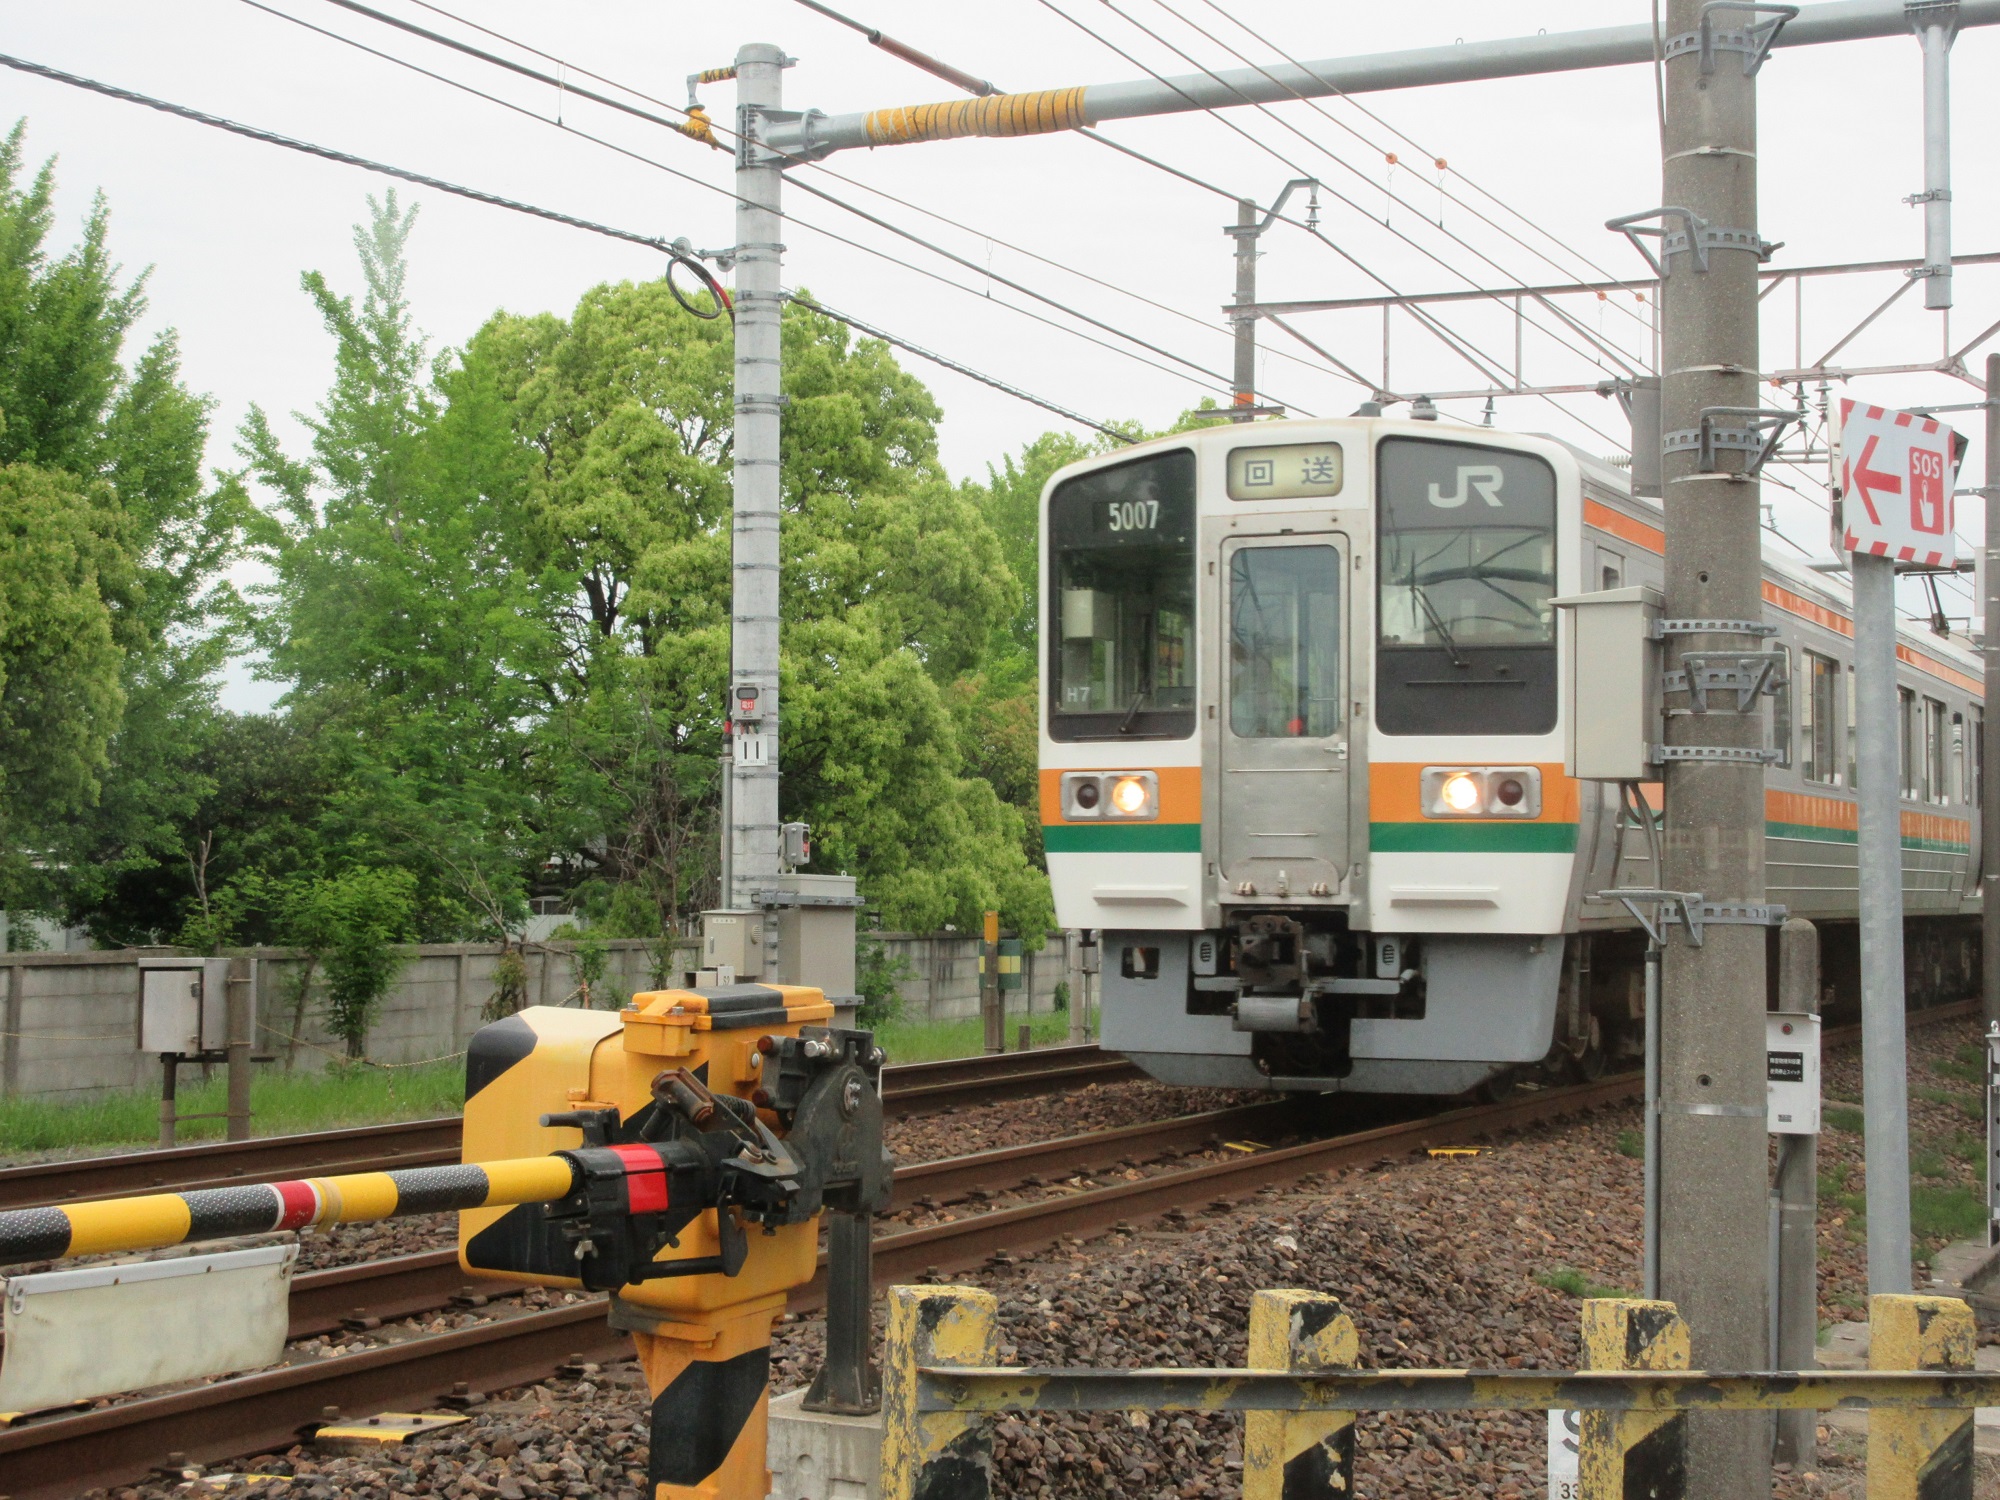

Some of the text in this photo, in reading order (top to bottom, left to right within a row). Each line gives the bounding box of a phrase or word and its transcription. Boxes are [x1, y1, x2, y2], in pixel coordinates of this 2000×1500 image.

[1245, 455, 1335, 487] 回送
[1912, 451, 1940, 479] SOS
[1428, 465, 1504, 508] JR
[1109, 500, 1159, 531] 5007
[1067, 686, 1091, 702] H7
